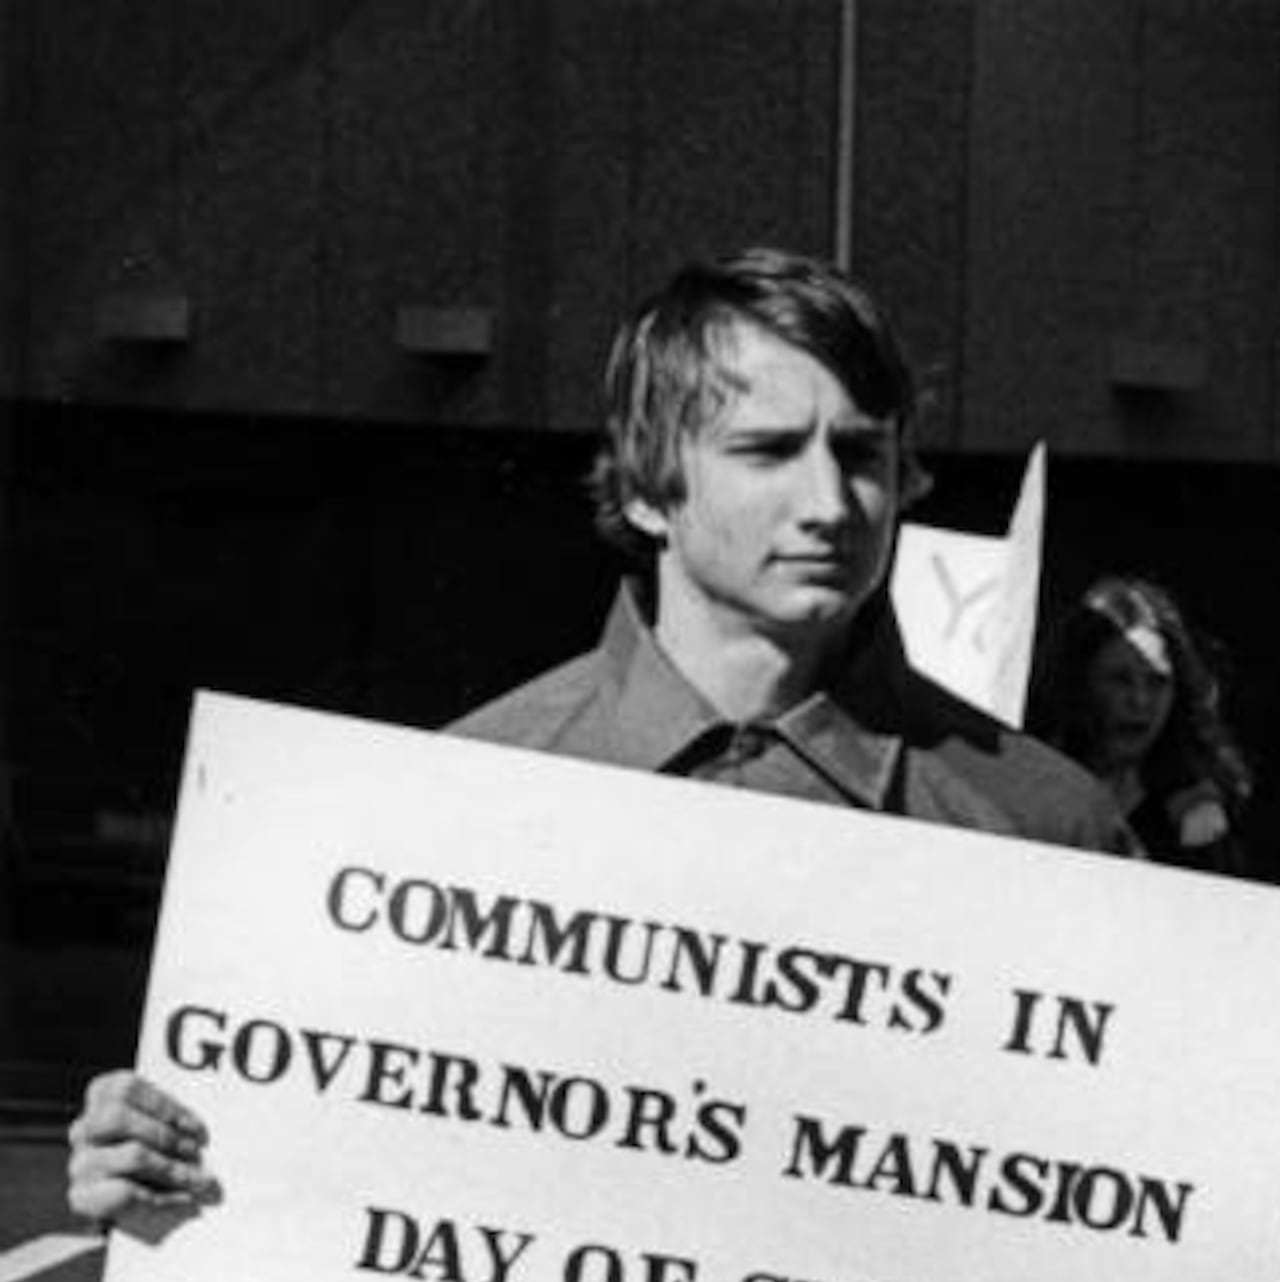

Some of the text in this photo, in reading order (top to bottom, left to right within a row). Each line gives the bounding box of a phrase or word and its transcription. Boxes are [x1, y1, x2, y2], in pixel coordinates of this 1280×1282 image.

[327, 867, 1115, 1067] COMMUNISTS IN
[165, 1005, 1195, 1244] GOVERNOR'S MANSION
